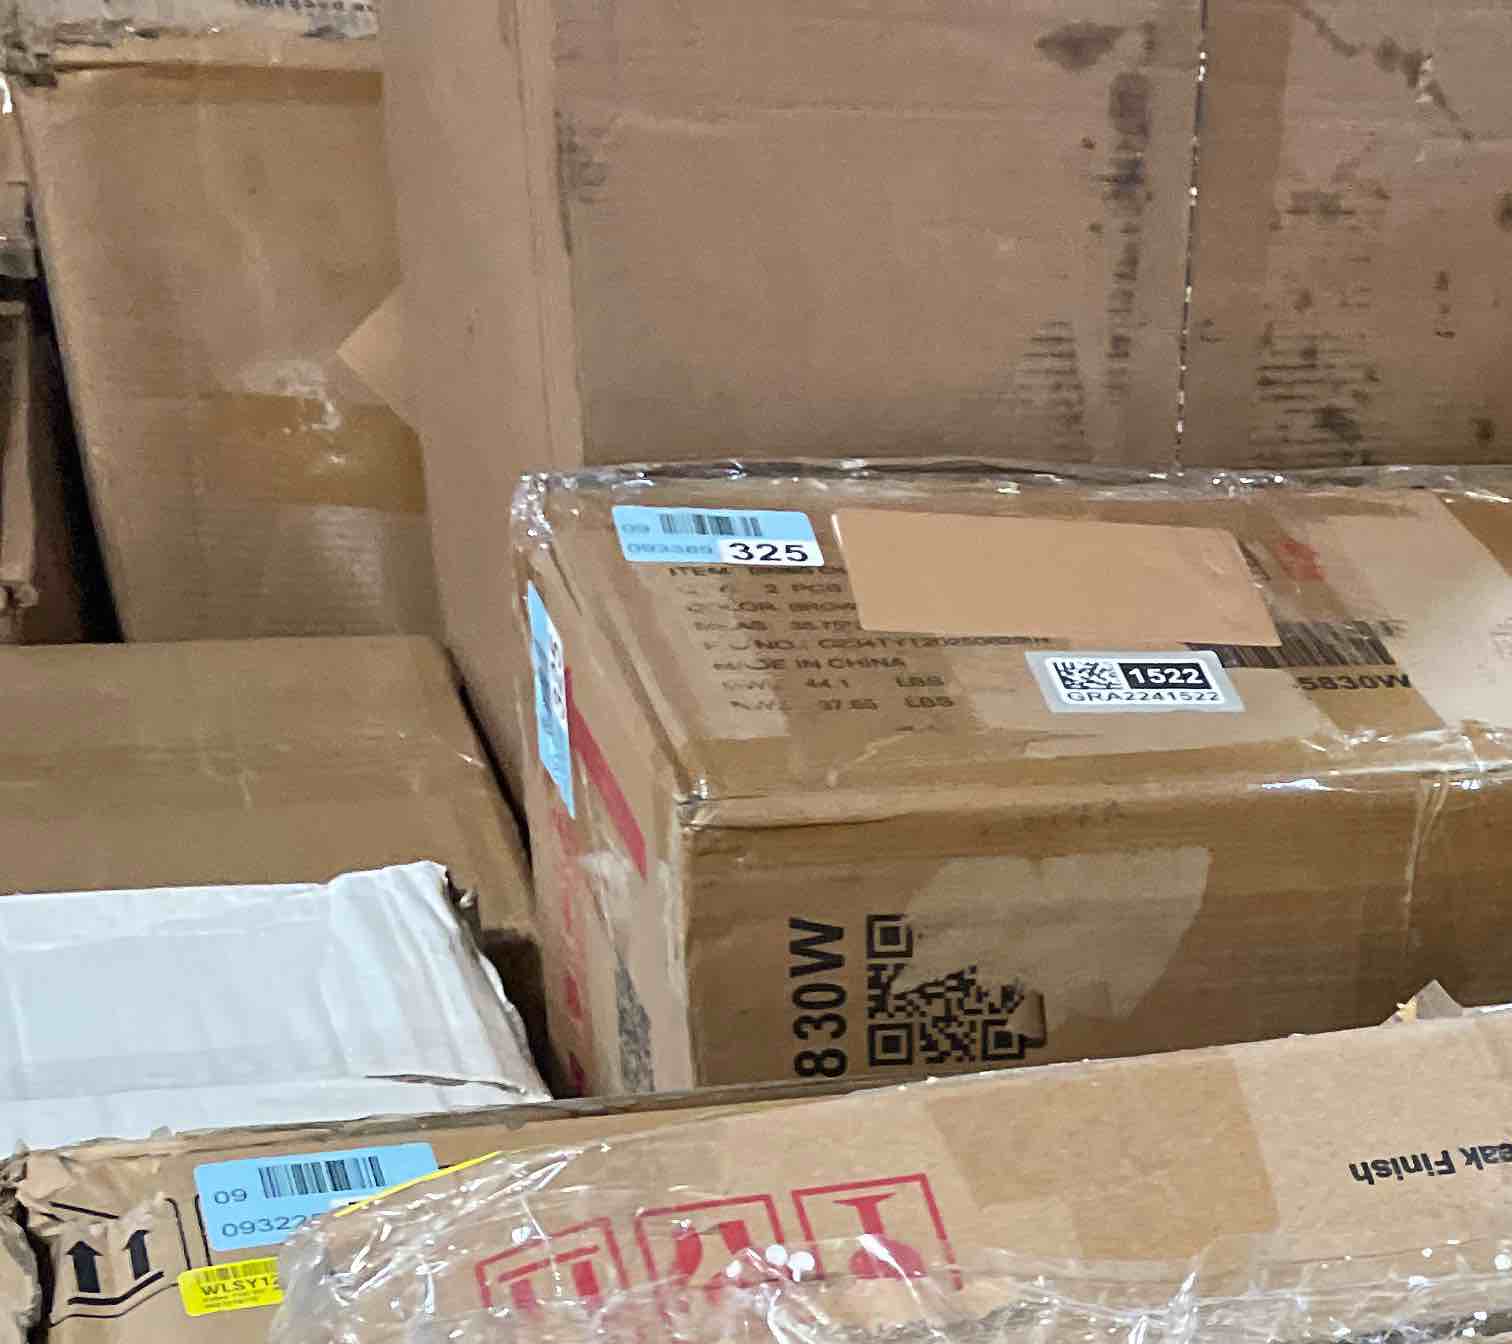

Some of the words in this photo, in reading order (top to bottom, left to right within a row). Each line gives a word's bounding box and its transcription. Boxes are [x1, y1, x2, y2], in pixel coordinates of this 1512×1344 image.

[729, 543, 809, 563] 325
[827, 656, 906, 671] CHINA
[1128, 667, 1204, 684] 1522
[1067, 691, 1219, 702] GRA2241522
[1348, 1150, 1457, 1185] Finish
[213, 1187, 248, 1205] 09
